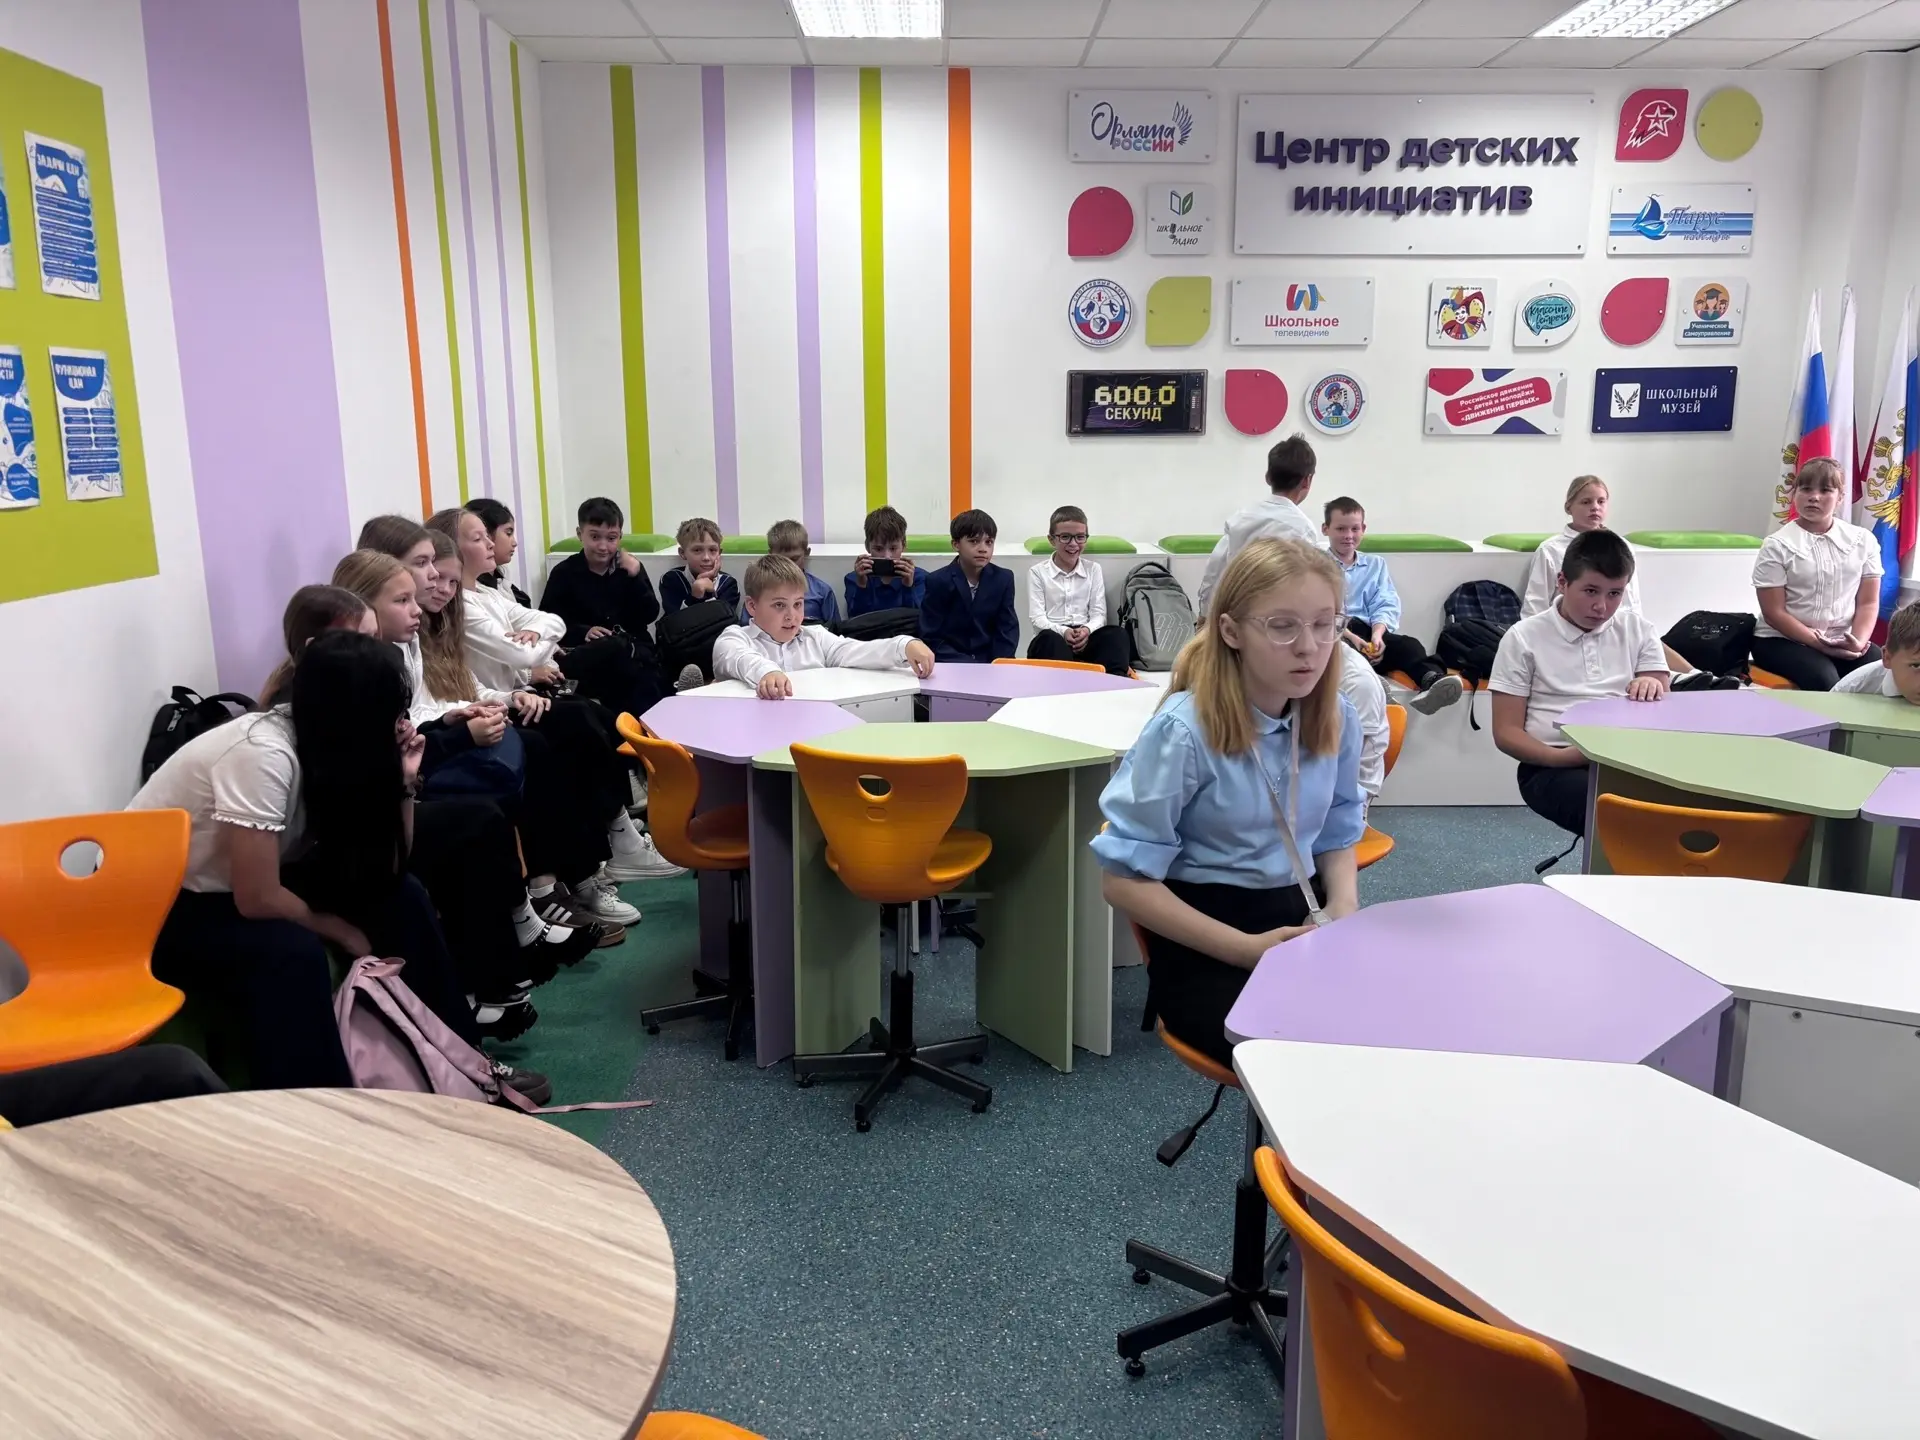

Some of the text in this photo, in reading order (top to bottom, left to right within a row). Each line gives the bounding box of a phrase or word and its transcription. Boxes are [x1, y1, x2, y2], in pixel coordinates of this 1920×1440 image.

[1091, 101, 1176, 146] Орлята
[1111, 138, 1174, 152] РОССИИ
[1255, 131, 1581, 172] Центр детских
[1294, 185, 1533, 216] инициатив
[1667, 205, 1726, 231] Парус
[1156, 224, 1204, 233] ШКЛЬНОЕ
[1172, 237, 1199, 246] РАДИО
[1265, 314, 1339, 327] Школьное
[1274, 329, 1330, 337] телевидение
[1095, 386, 1176, 405] 600.0
[1459, 382, 1534, 406] Российское движение
[1646, 385, 1718, 399] ШКОЛЬНЫЙ
[1460, 396, 1540, 421] «ДВИЖЕНИЕ ПЕРВЫХ»
[1473, 400, 1494, 411] детей
[1660, 400, 1701, 414] МУЗЕЙ
[1105, 407, 1162, 421] СЕКУНД
